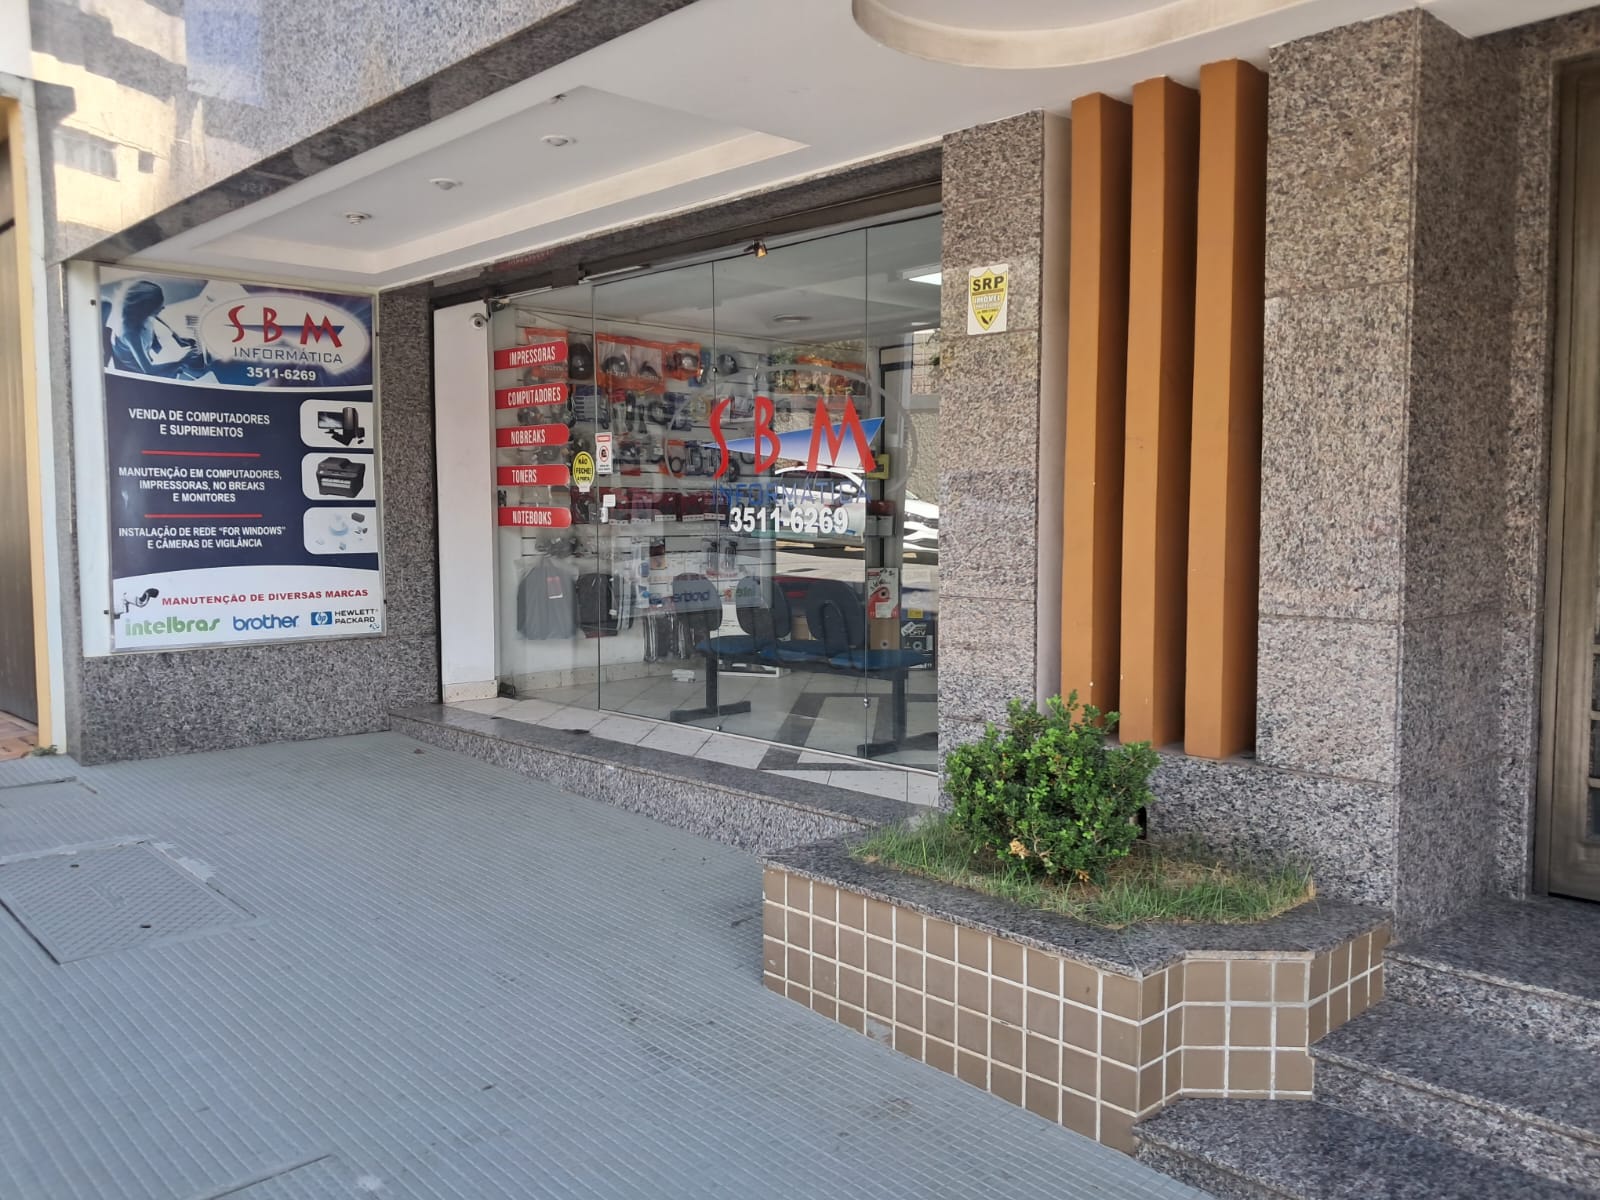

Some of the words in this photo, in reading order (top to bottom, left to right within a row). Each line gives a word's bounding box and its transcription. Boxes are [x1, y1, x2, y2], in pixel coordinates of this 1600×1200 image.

[972, 275, 1004, 291] SRP
[234, 347, 342, 363] INFORMÁTICA
[509, 346, 556, 366] IMPRESSORAS
[247, 366, 316, 381] 3511-6269
[507, 387, 561, 406] COMPUTADORES
[128, 408, 166, 420] VENDA
[169, 410, 183, 421] DE
[186, 411, 270, 425] COMPUTADORES
[160, 424, 167, 435] E
[170, 425, 243, 437] SUPRIMENTOS
[511, 429, 546, 445] NOBREAKS
[119, 467, 187, 479] MANUTENÇÃO
[190, 469, 203, 478] EM
[206, 469, 282, 480] COMPUTADORES,
[512, 469, 537, 484] TONERS
[140, 480, 211, 491] IMPRESSORAS,
[213, 482, 227, 490] NO
[229, 482, 265, 490] BREAKS
[173, 493, 179, 502] E
[182, 493, 236, 502] MONITORES
[512, 510, 552, 525] NOTEBOOKS
[729, 507, 848, 534] 3511-6269
[119, 525, 177, 538] INSTALAÇÃO
[179, 527, 191, 536] DE
[193, 527, 216, 536] REDE
[148, 540, 154, 549] E
[156, 538, 200, 549] CÂMERAS
[202, 539, 214, 548] DE
[216, 537, 262, 548] VIGILÂNCIA
[250, 593, 264, 602] DE
[268, 591, 322, 601] DIVERSAS
[325, 589, 369, 598] MARCAS
[334, 608, 375, 617] HEWLETT
[125, 616, 221, 637] intelbras
[232, 614, 299, 632] brother
[334, 616, 376, 625] PACKARD
